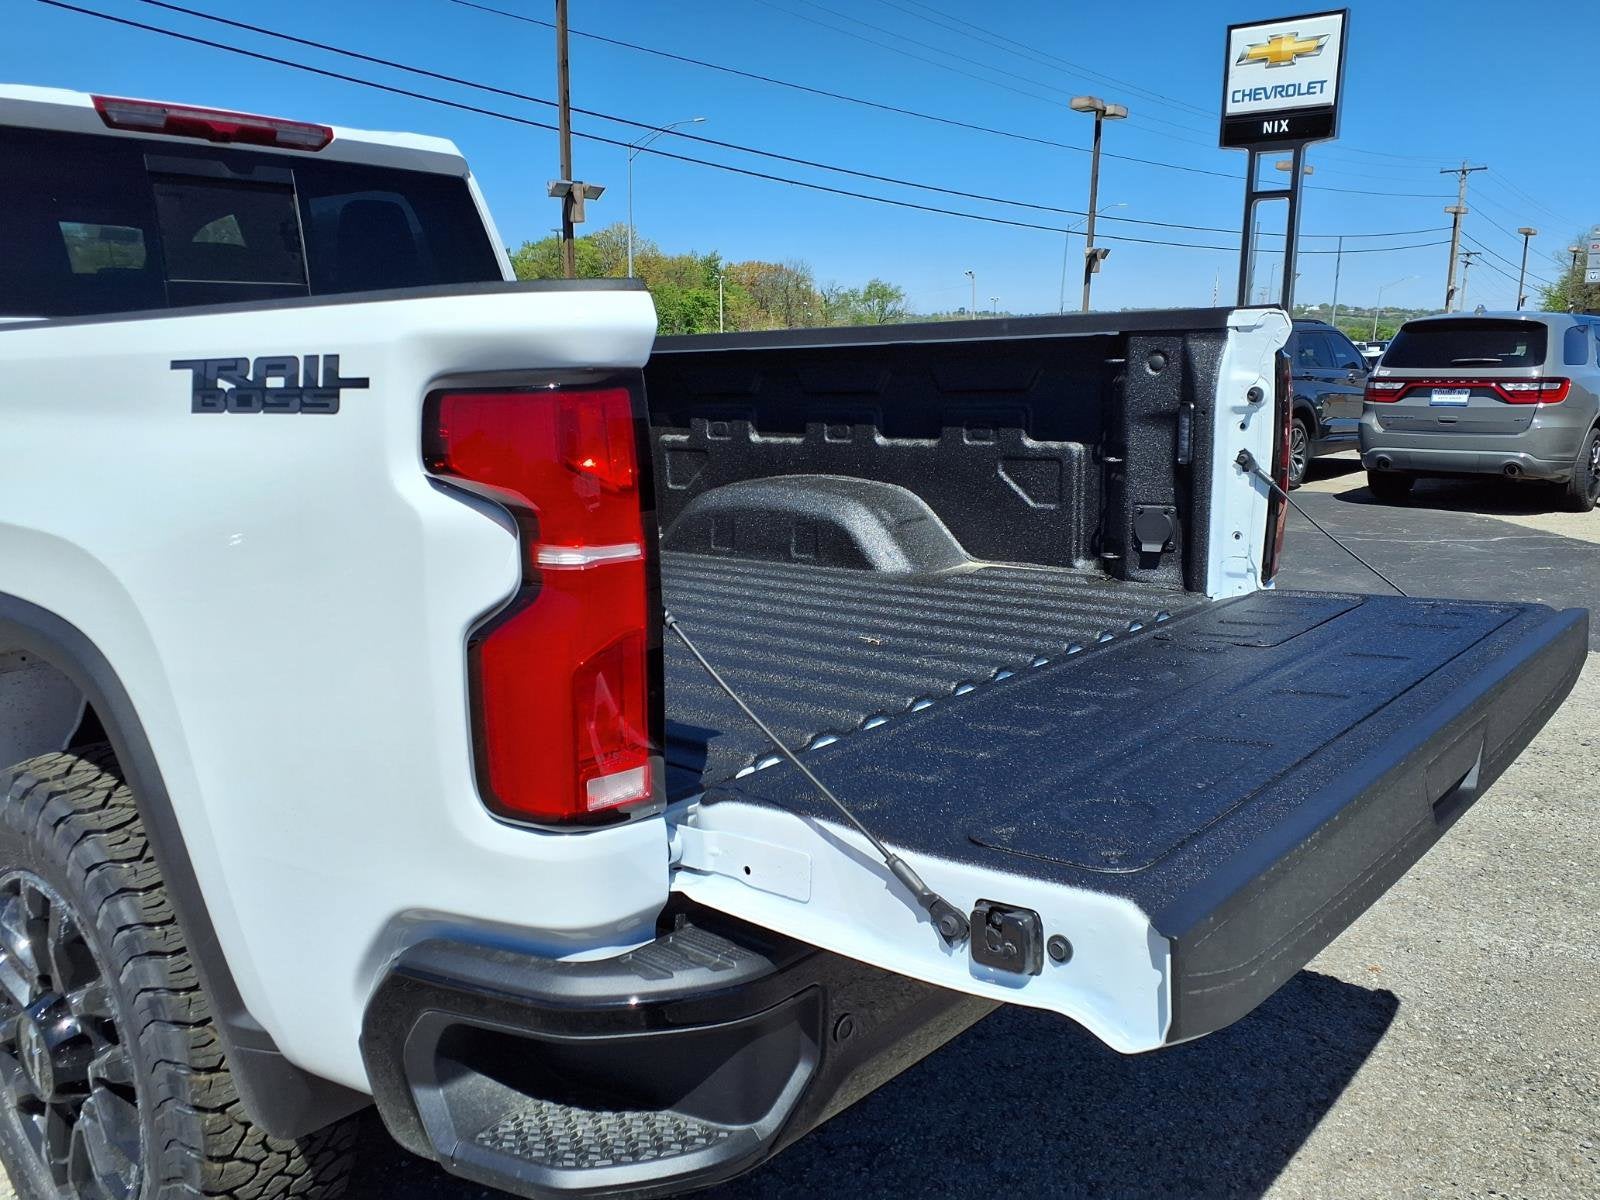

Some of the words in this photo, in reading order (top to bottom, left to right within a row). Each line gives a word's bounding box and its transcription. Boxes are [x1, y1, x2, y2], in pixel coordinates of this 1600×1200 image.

[1231, 80, 1328, 103] CHEVROLET
[1262, 119, 1290, 134] NIX
[170, 354, 370, 389] TRAIL
[191, 387, 341, 414] BOSS
